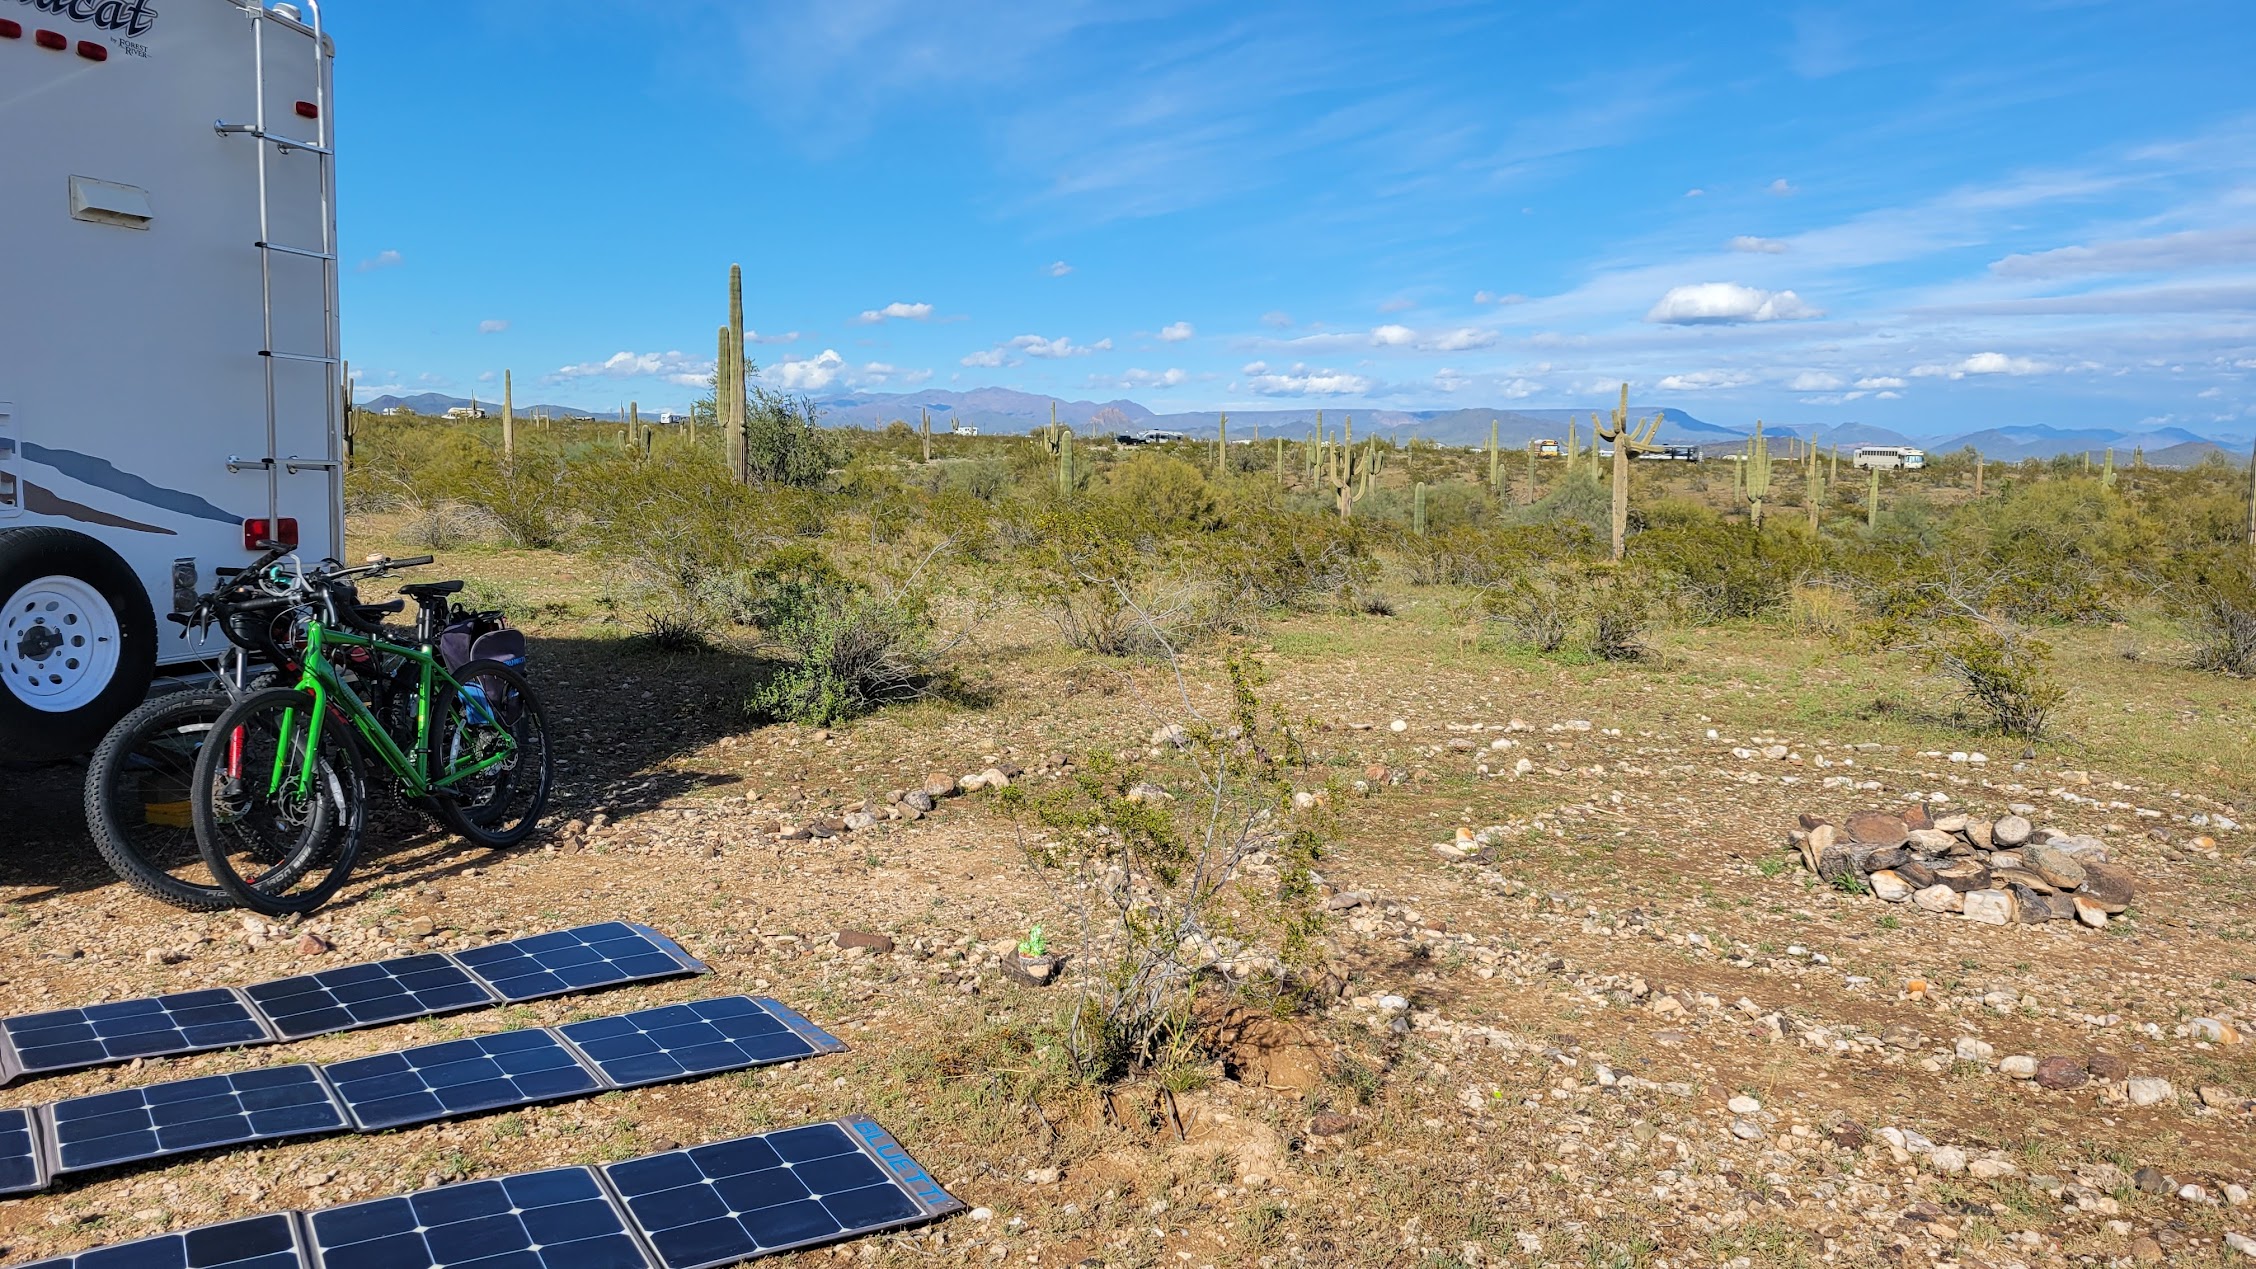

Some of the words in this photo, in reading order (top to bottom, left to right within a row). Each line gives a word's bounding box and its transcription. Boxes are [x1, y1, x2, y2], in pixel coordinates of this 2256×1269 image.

[118, 38, 148, 53] FOREST
[125, 47, 149, 58] RIVER
[852, 1122, 949, 1205] BLUETTI
